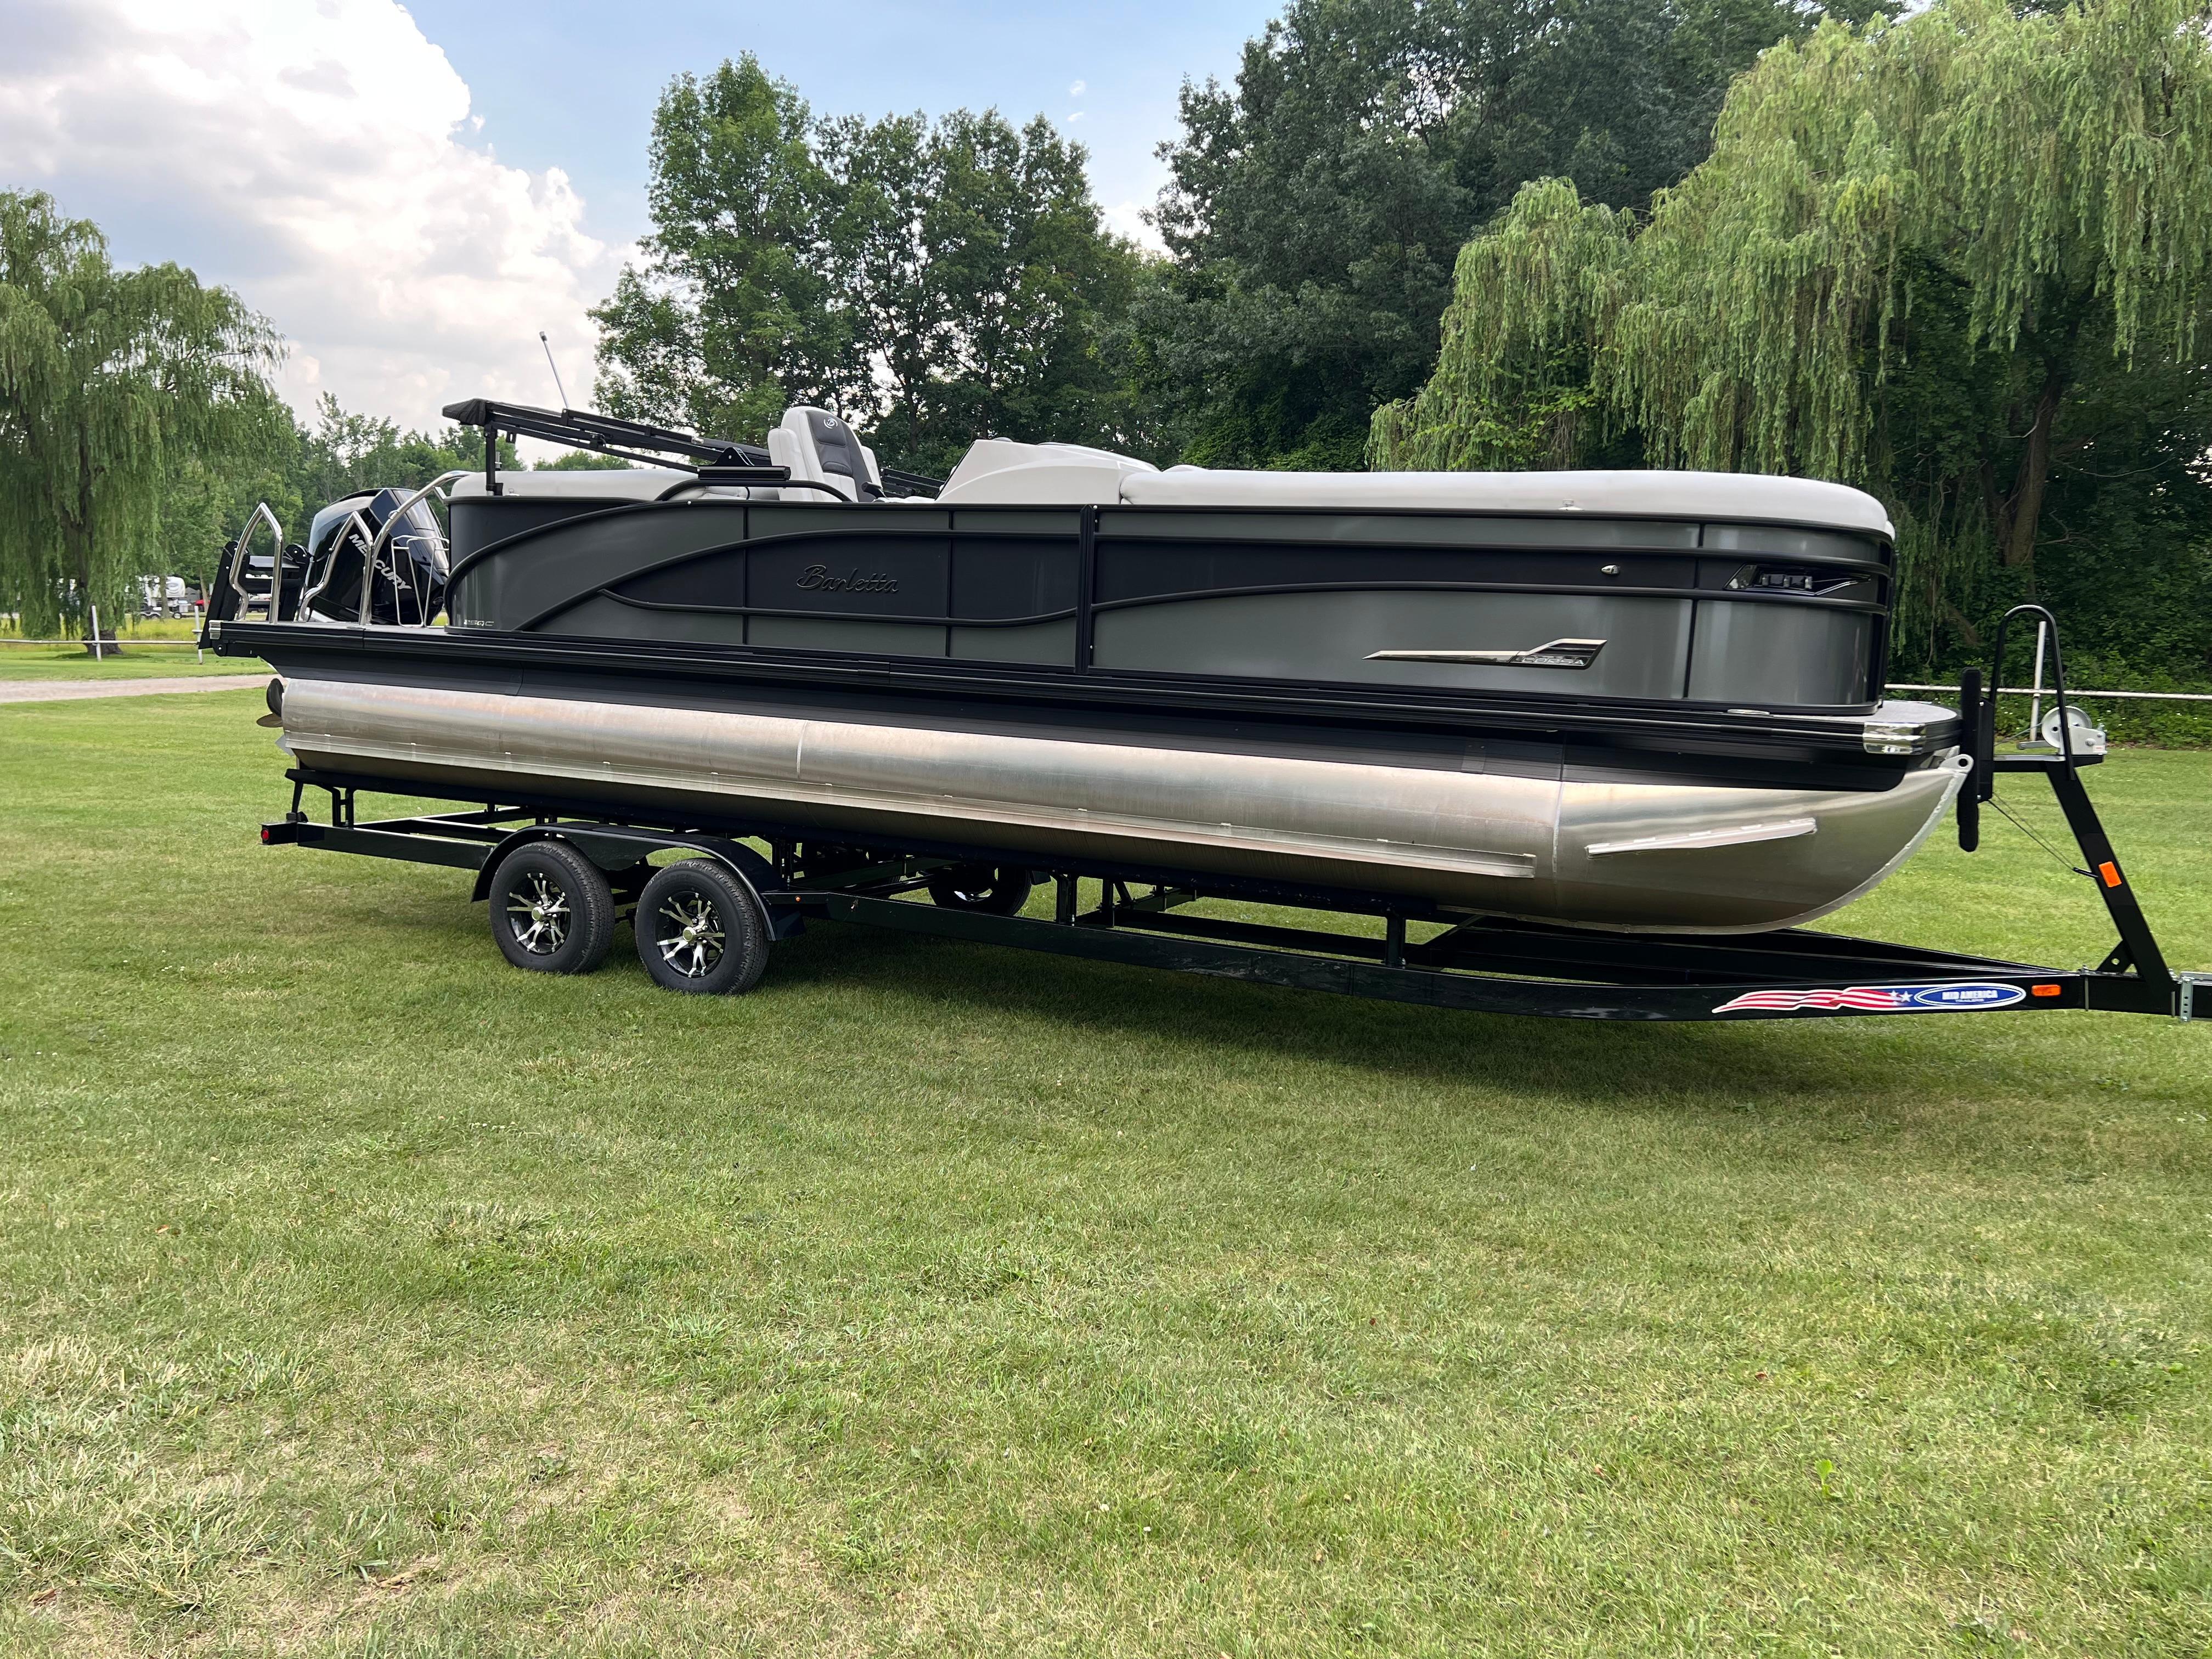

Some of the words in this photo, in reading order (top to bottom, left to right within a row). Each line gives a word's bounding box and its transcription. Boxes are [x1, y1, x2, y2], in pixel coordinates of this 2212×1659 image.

[348, 534, 412, 590] MECURY
[796, 565, 899, 592] Barletta
[1521, 657, 1584, 665] CORSA
[1960, 990, 1998, 999] AMERICA
